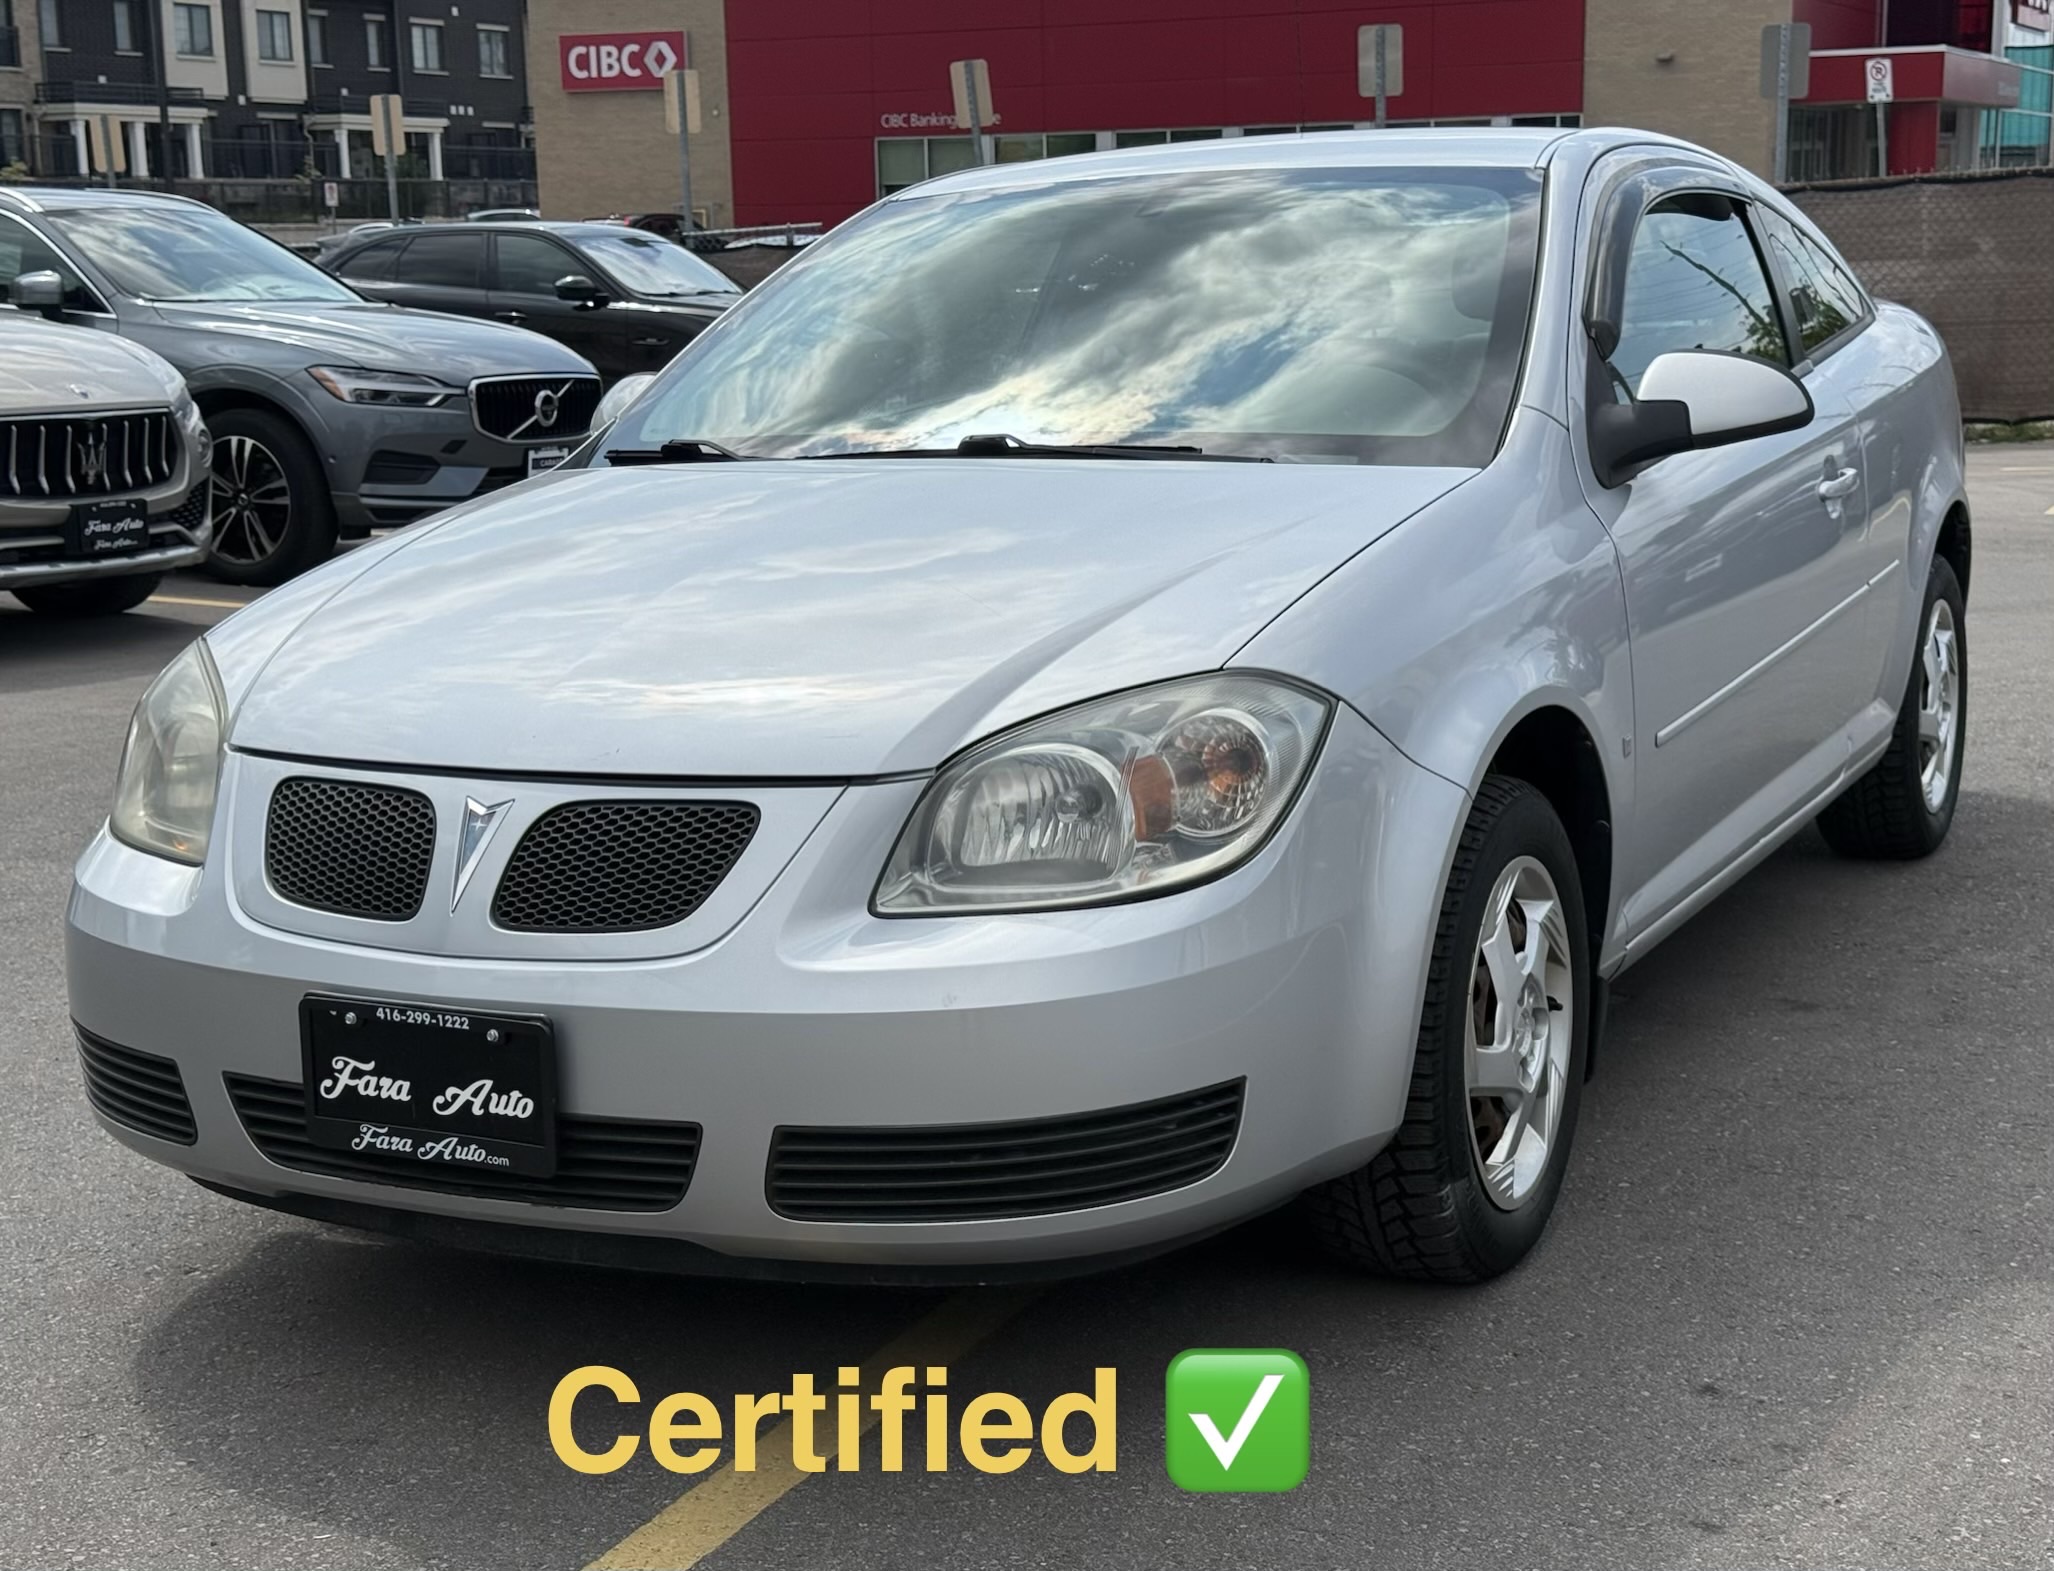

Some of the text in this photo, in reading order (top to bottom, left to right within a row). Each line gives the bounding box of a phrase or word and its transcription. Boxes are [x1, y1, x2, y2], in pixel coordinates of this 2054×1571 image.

[568, 44, 642, 79] CIBC
[880, 112, 958, 129] CIBC Banking
[376, 1007, 470, 1030] 416-299-1222
[319, 1056, 535, 1119] Fara Auto
[351, 1123, 413, 1153] Fara
